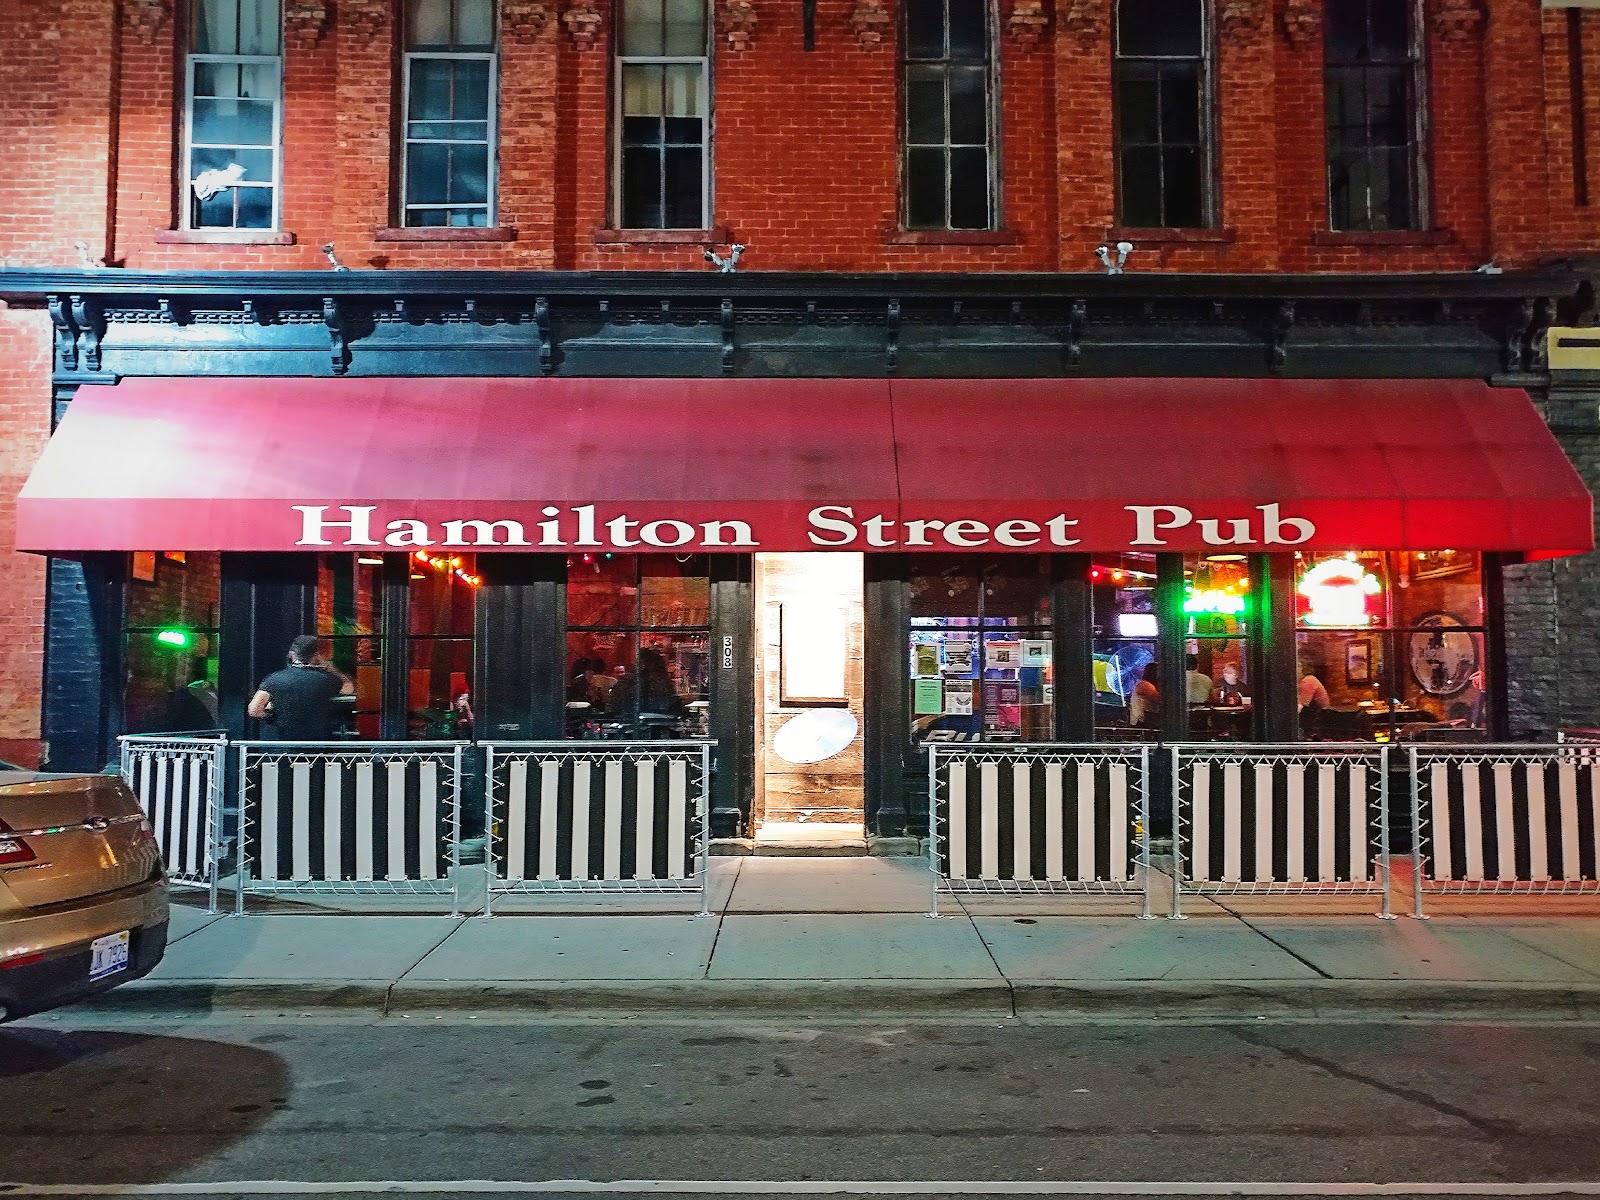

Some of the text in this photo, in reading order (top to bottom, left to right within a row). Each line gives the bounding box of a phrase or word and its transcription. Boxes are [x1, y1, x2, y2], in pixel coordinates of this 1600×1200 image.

[290, 502, 1317, 547] Hamilton Street Pub
[724, 637, 732, 667] 308
